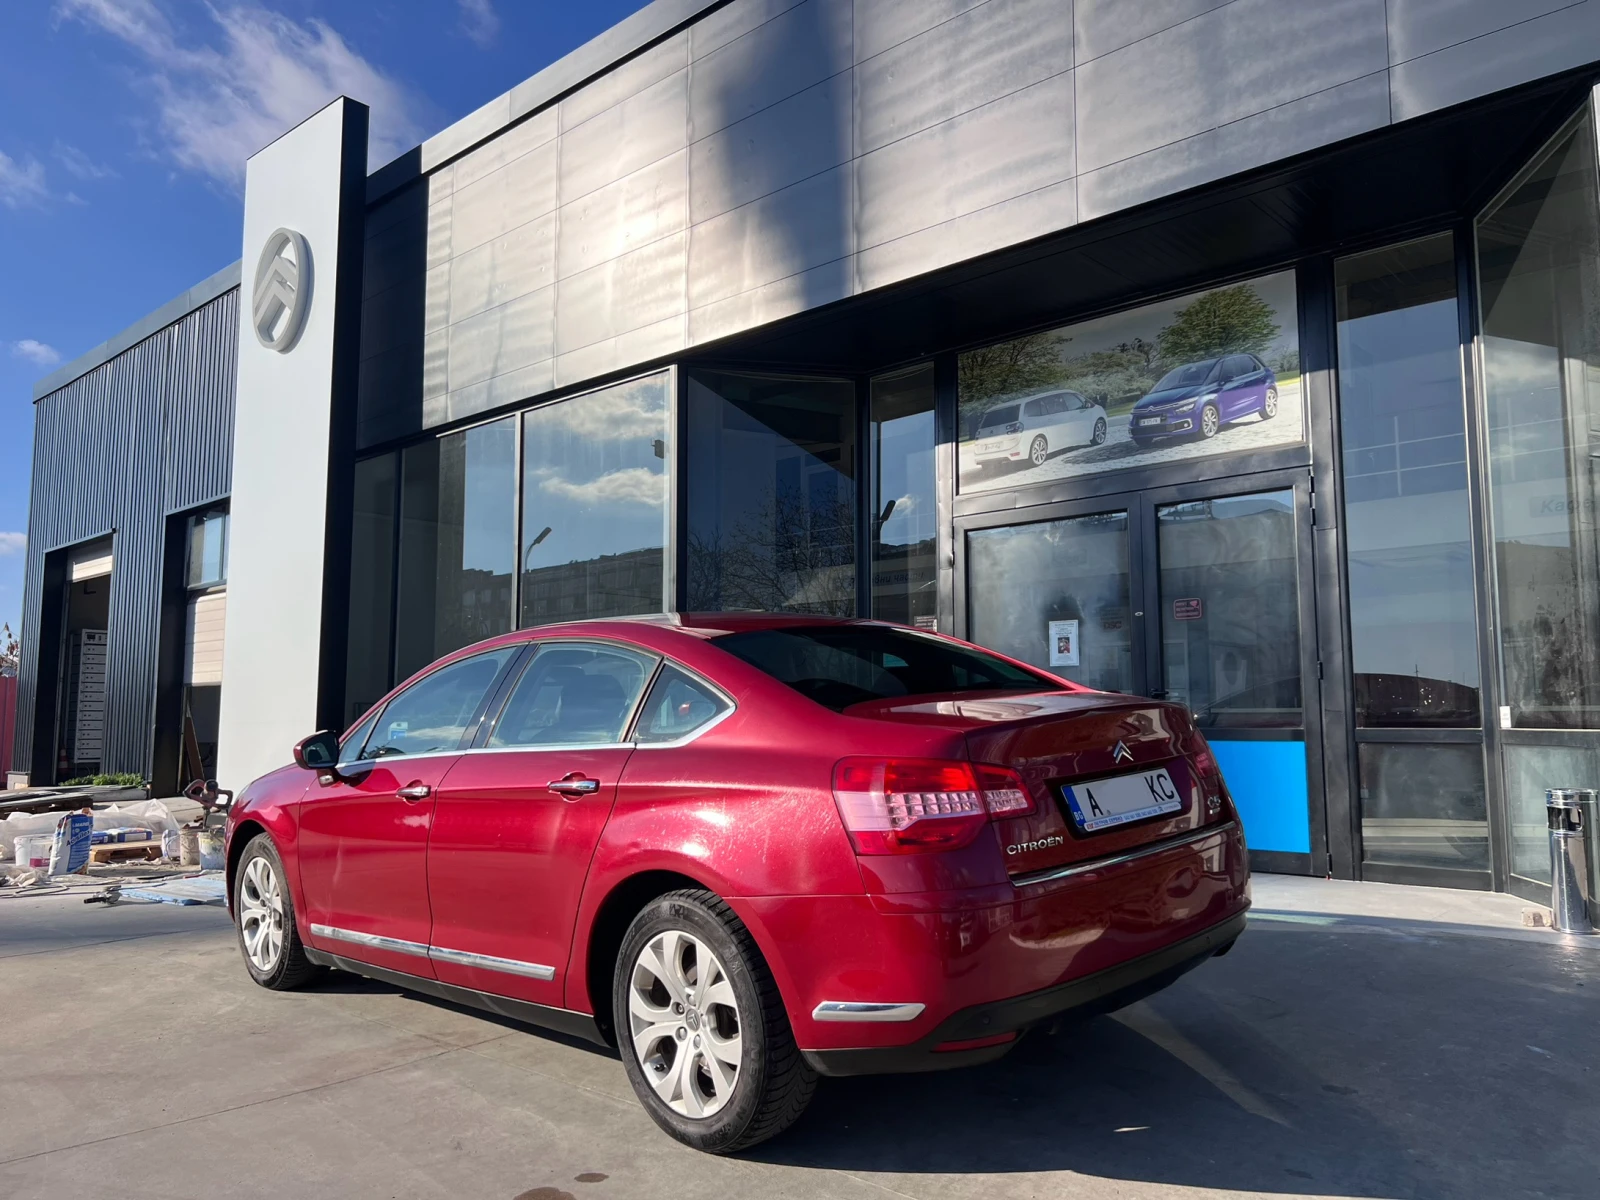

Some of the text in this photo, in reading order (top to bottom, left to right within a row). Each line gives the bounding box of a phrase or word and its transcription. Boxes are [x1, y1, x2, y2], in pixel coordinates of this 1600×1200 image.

[1086, 787, 1104, 818] A
[1144, 773, 1175, 803] KC
[1074, 811, 1084, 821] BG
[1006, 835, 1064, 855] CITROËN
